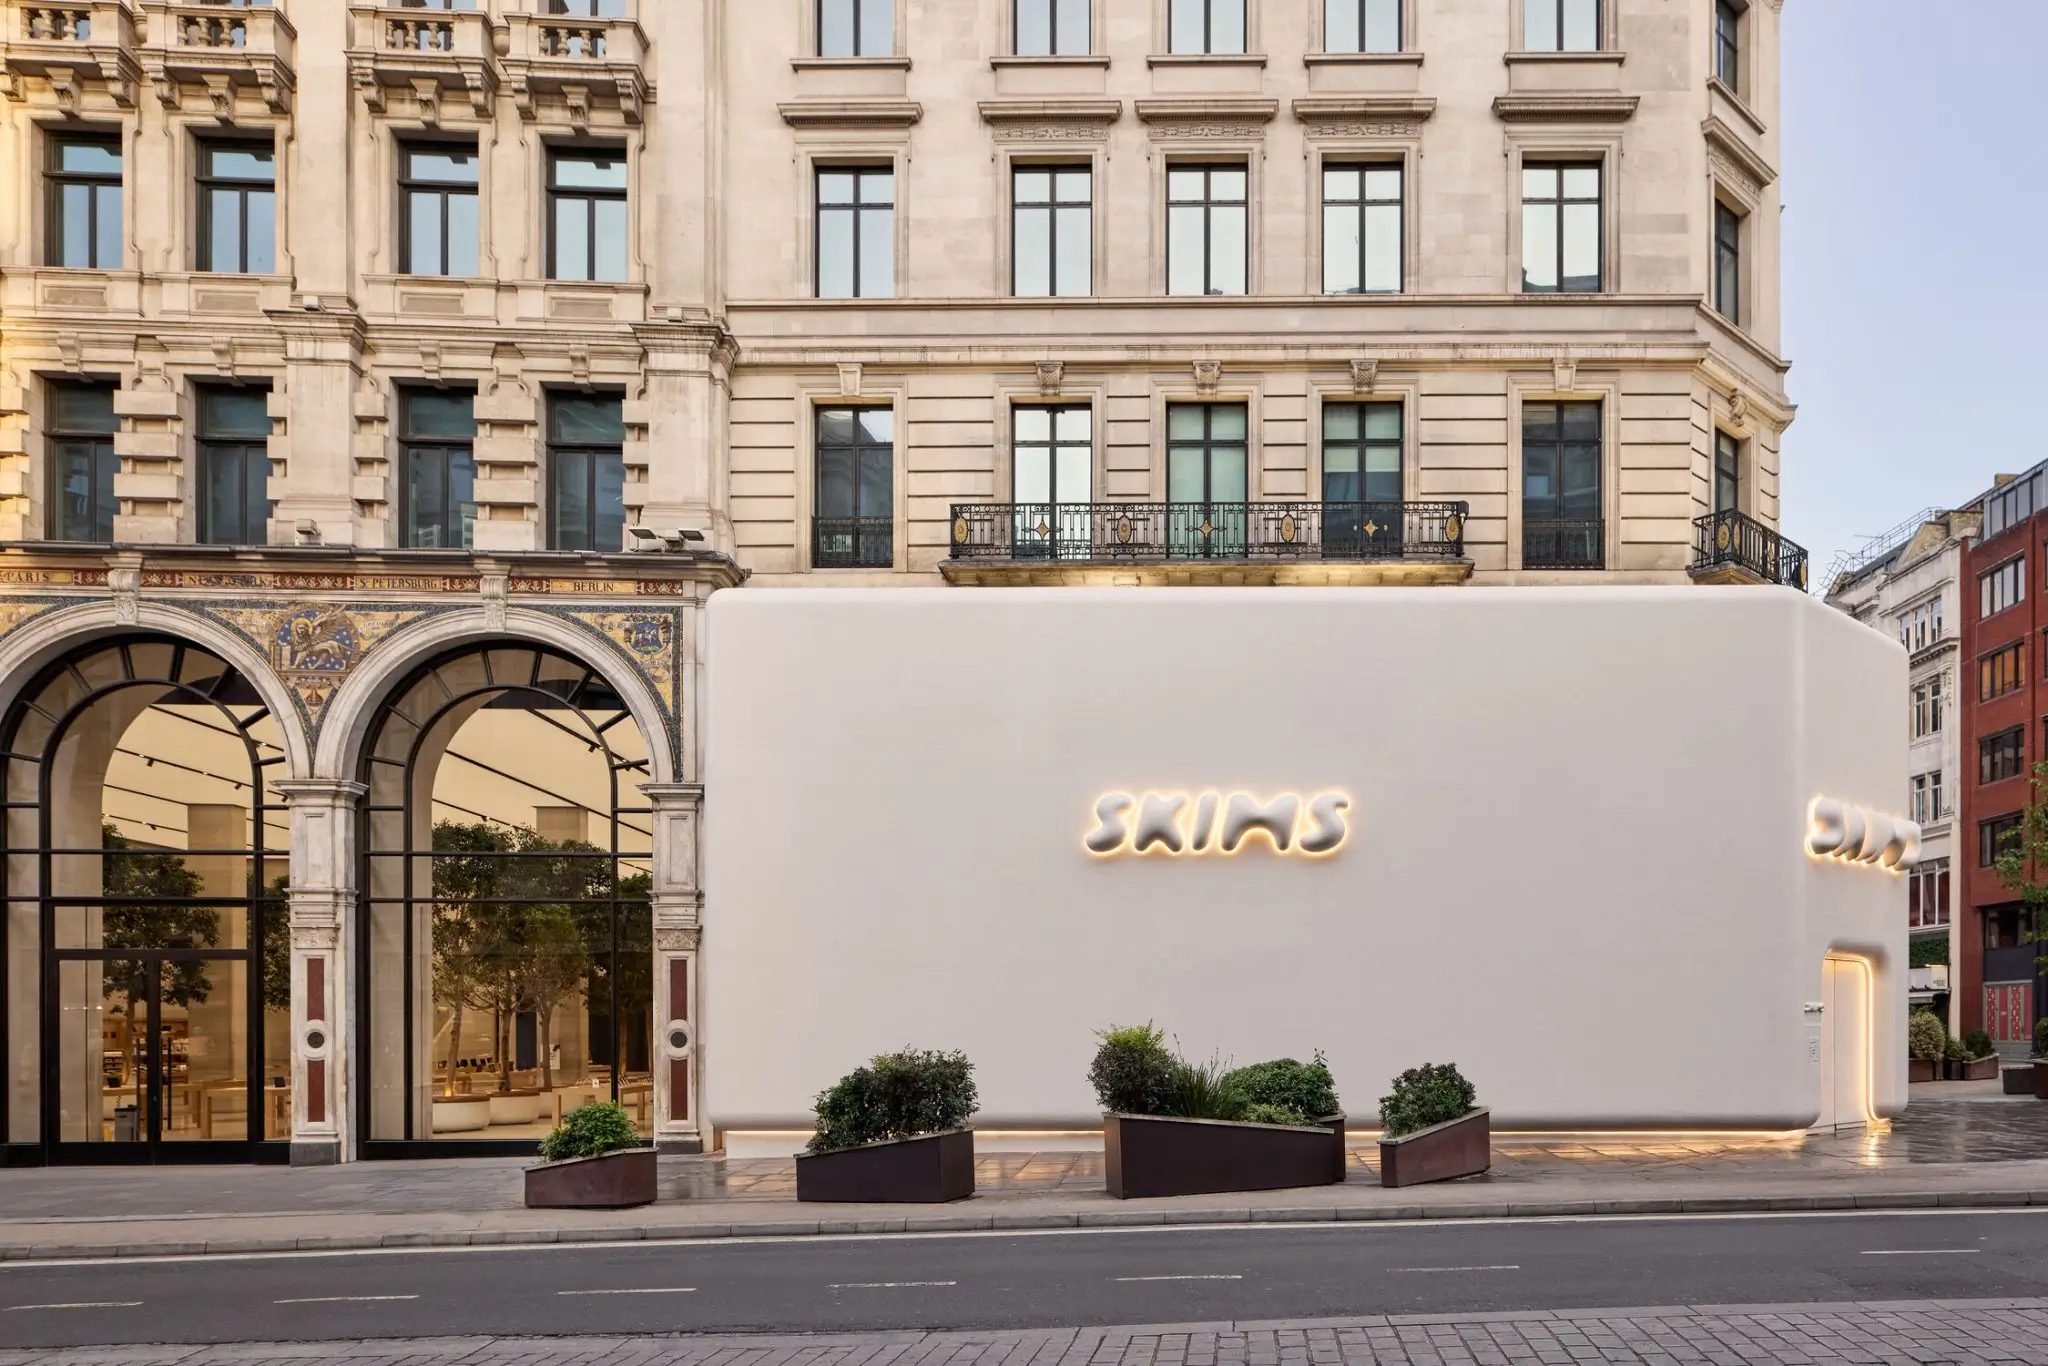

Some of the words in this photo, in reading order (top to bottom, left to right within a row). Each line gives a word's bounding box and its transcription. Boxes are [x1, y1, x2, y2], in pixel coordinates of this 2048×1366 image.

[6, 571, 50, 582] PARIS
[372, 579, 437, 589] PETERSBURG
[573, 582, 614, 592] BERLIN
[1085, 792, 1349, 853] SKIMS
